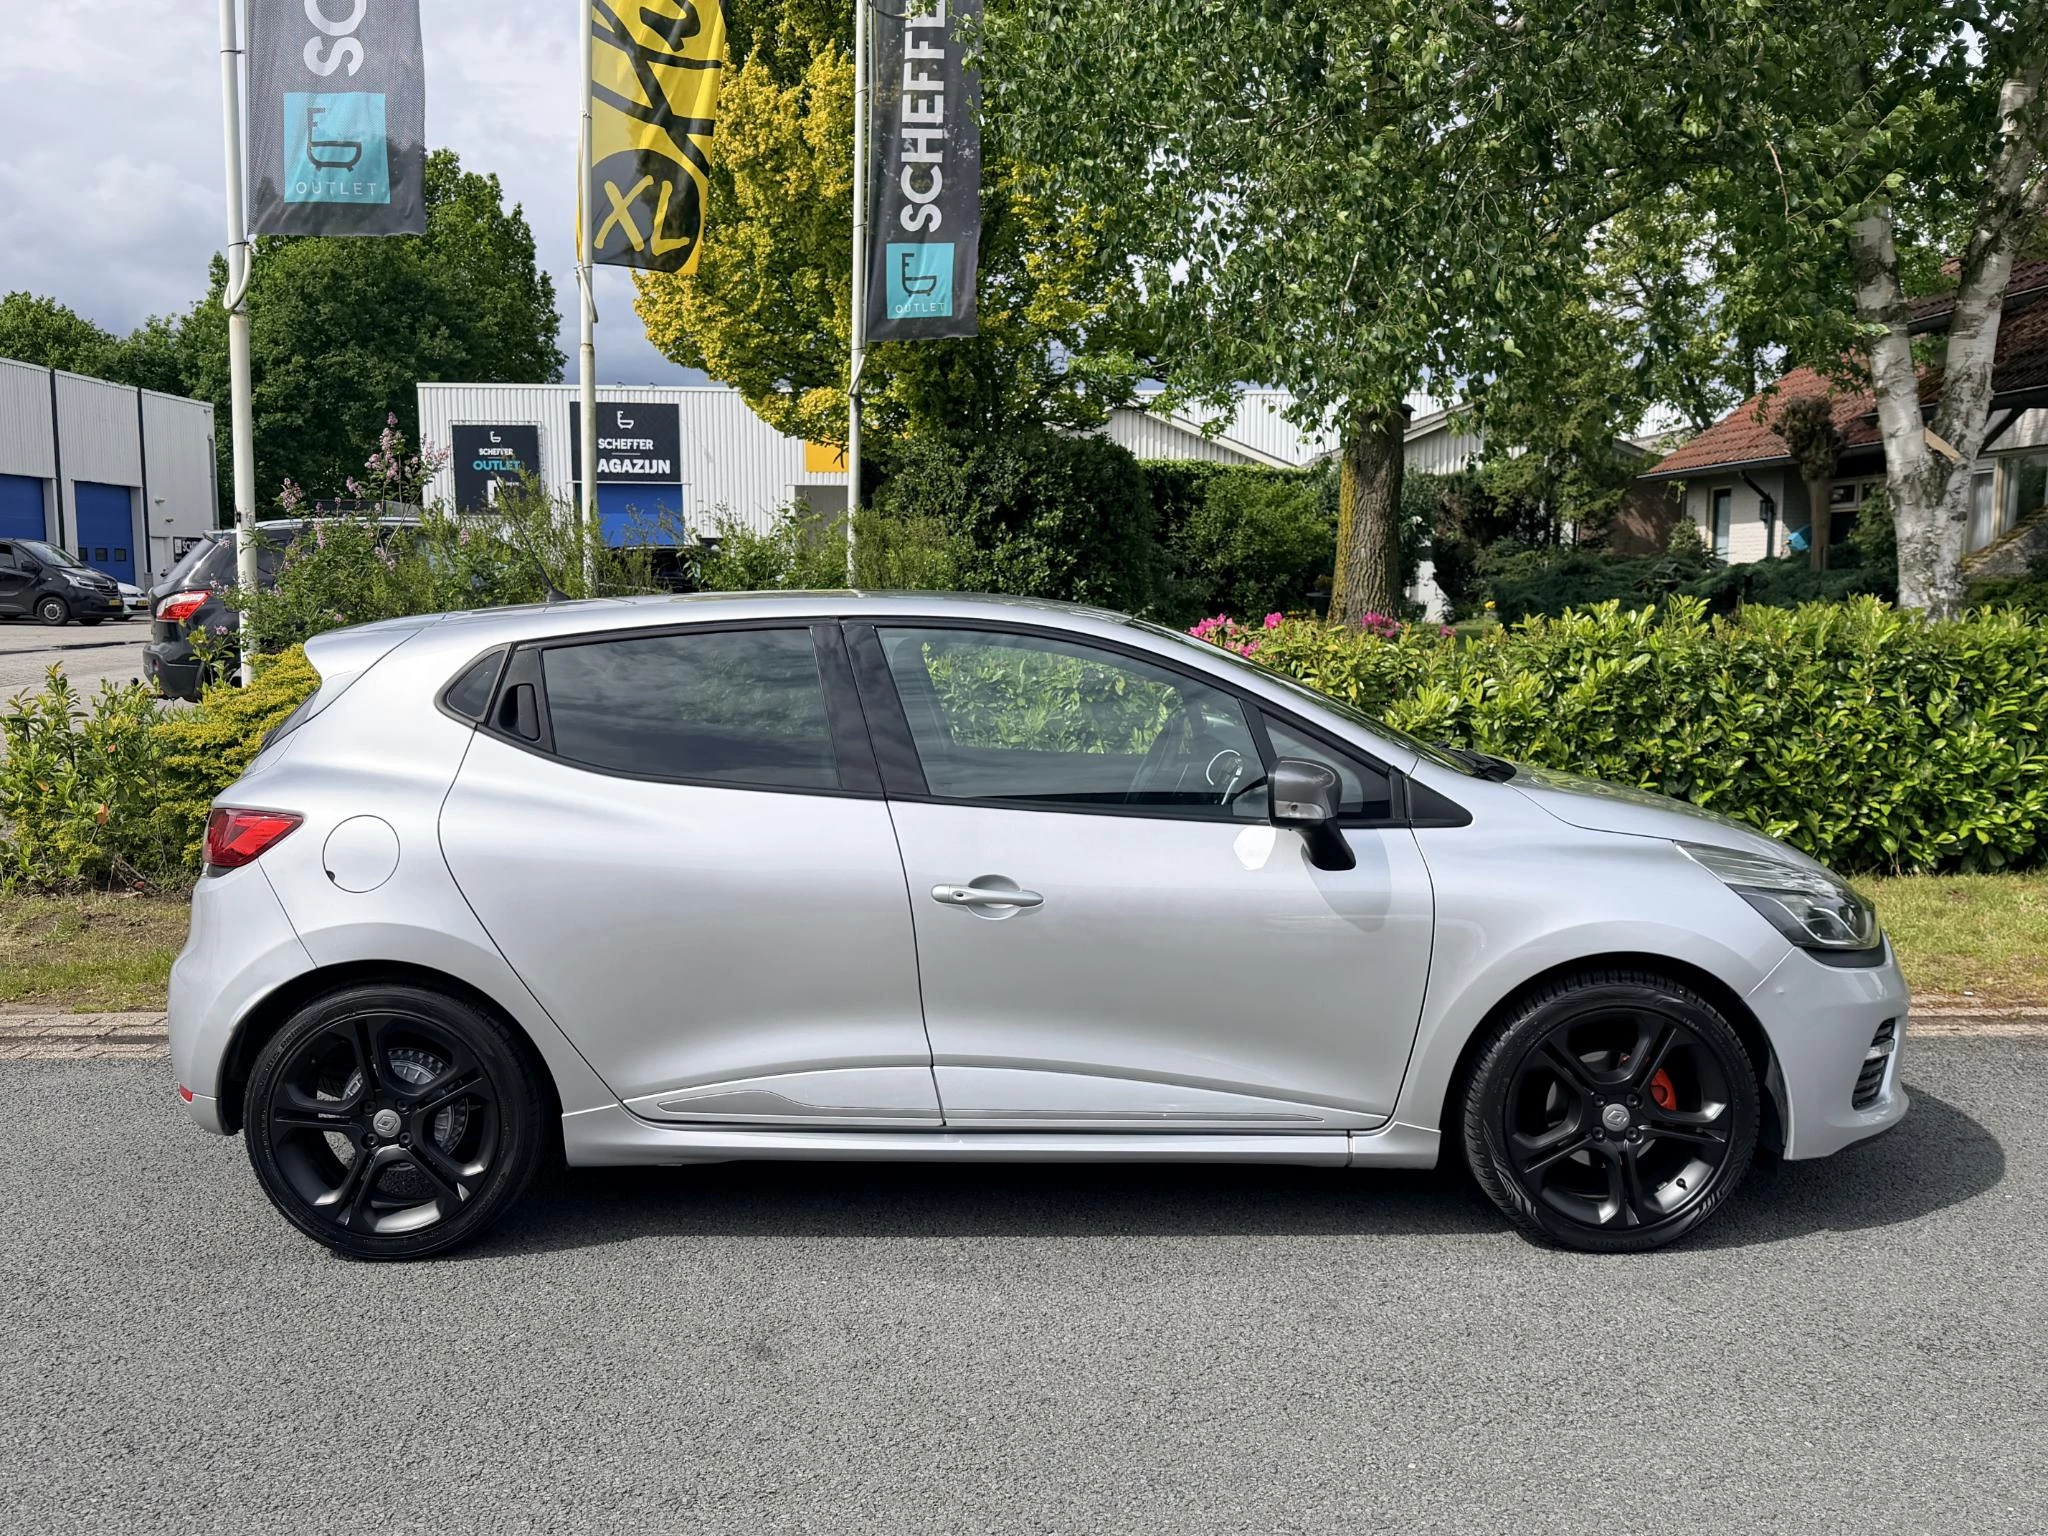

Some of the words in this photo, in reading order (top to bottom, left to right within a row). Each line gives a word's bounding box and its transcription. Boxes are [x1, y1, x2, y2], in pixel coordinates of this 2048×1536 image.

[296, 182, 377, 198] OUTLET
[594, 175, 690, 257] XL
[895, 302, 945, 314] OUTLET
[598, 438, 654, 450] SCHEFFER
[478, 447, 514, 456] SCHEFFER
[472, 460, 521, 471] OUTLET
[596, 458, 671, 475] AGAZIJN
